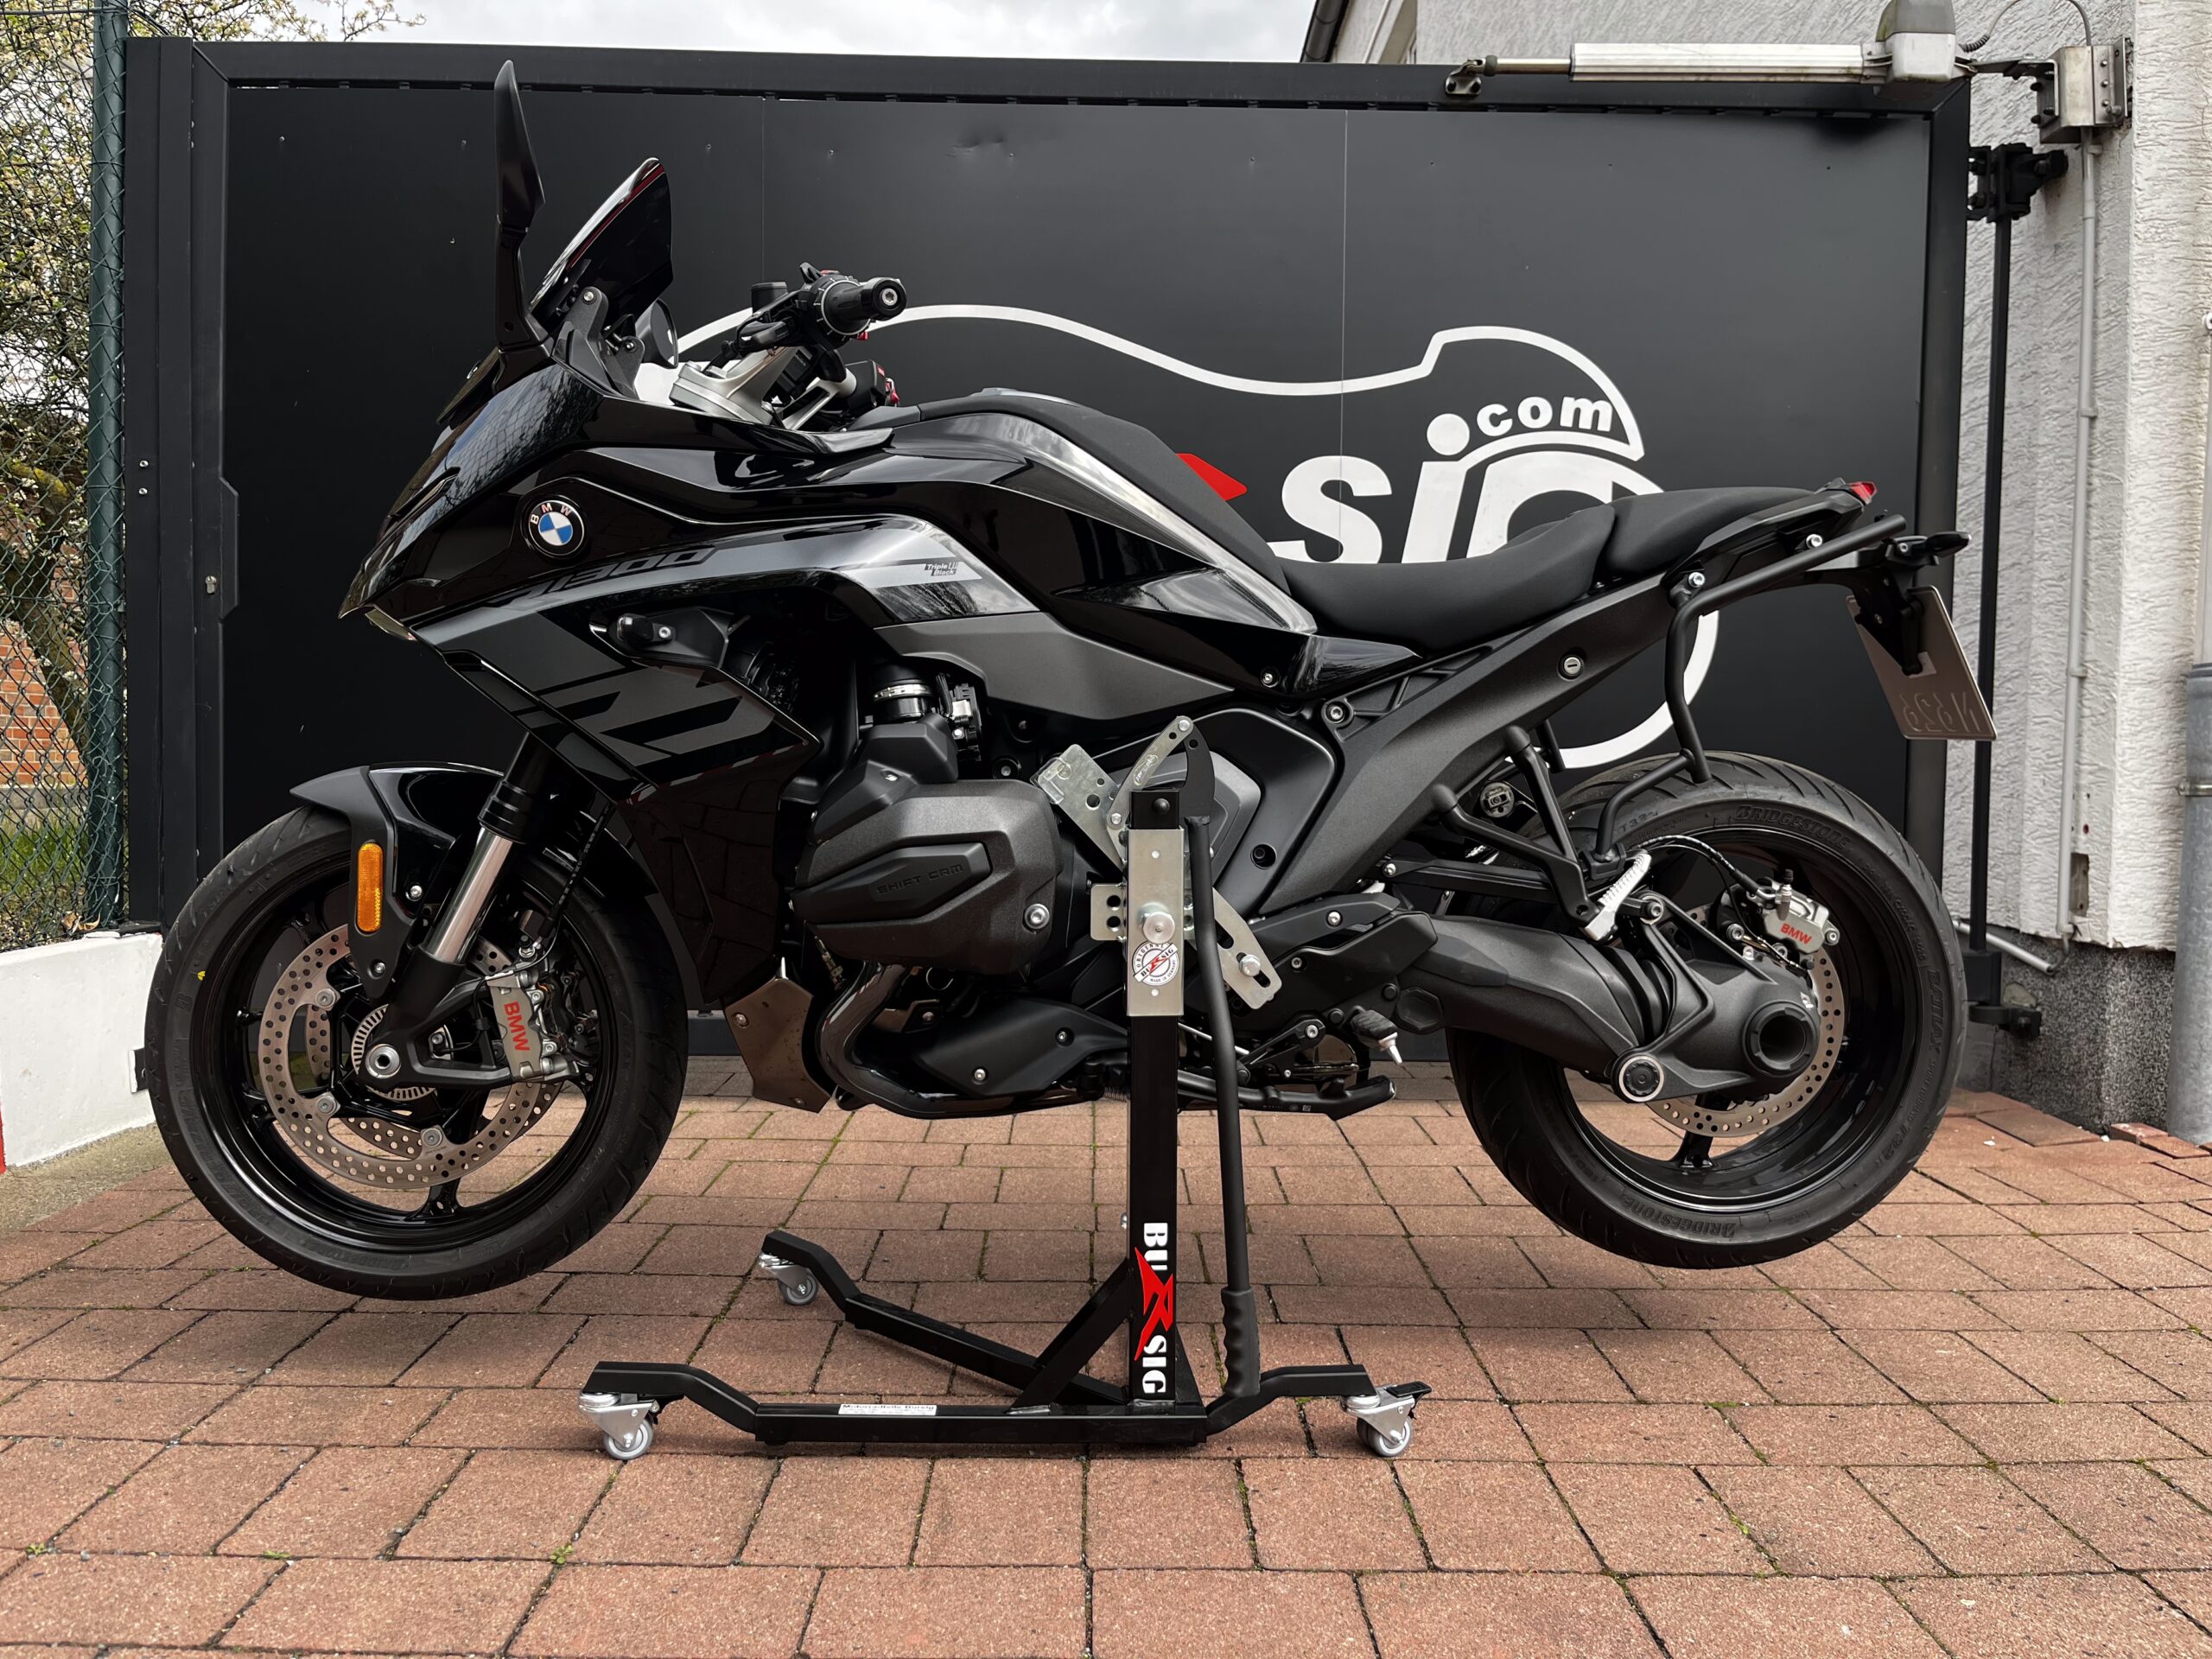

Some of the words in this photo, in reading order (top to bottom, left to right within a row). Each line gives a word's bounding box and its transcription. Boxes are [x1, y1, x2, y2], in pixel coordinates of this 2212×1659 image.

[530, 502, 574, 525] BMW
[1735, 804, 1853, 851] BRIDGESTONE
[876, 875, 921, 894] SHIFT
[927, 864, 964, 881] CAM
[1781, 923, 1813, 944] BMW
[504, 1001, 531, 1052] BMW
[1620, 1197, 1737, 1238] BRIDGESTONE
